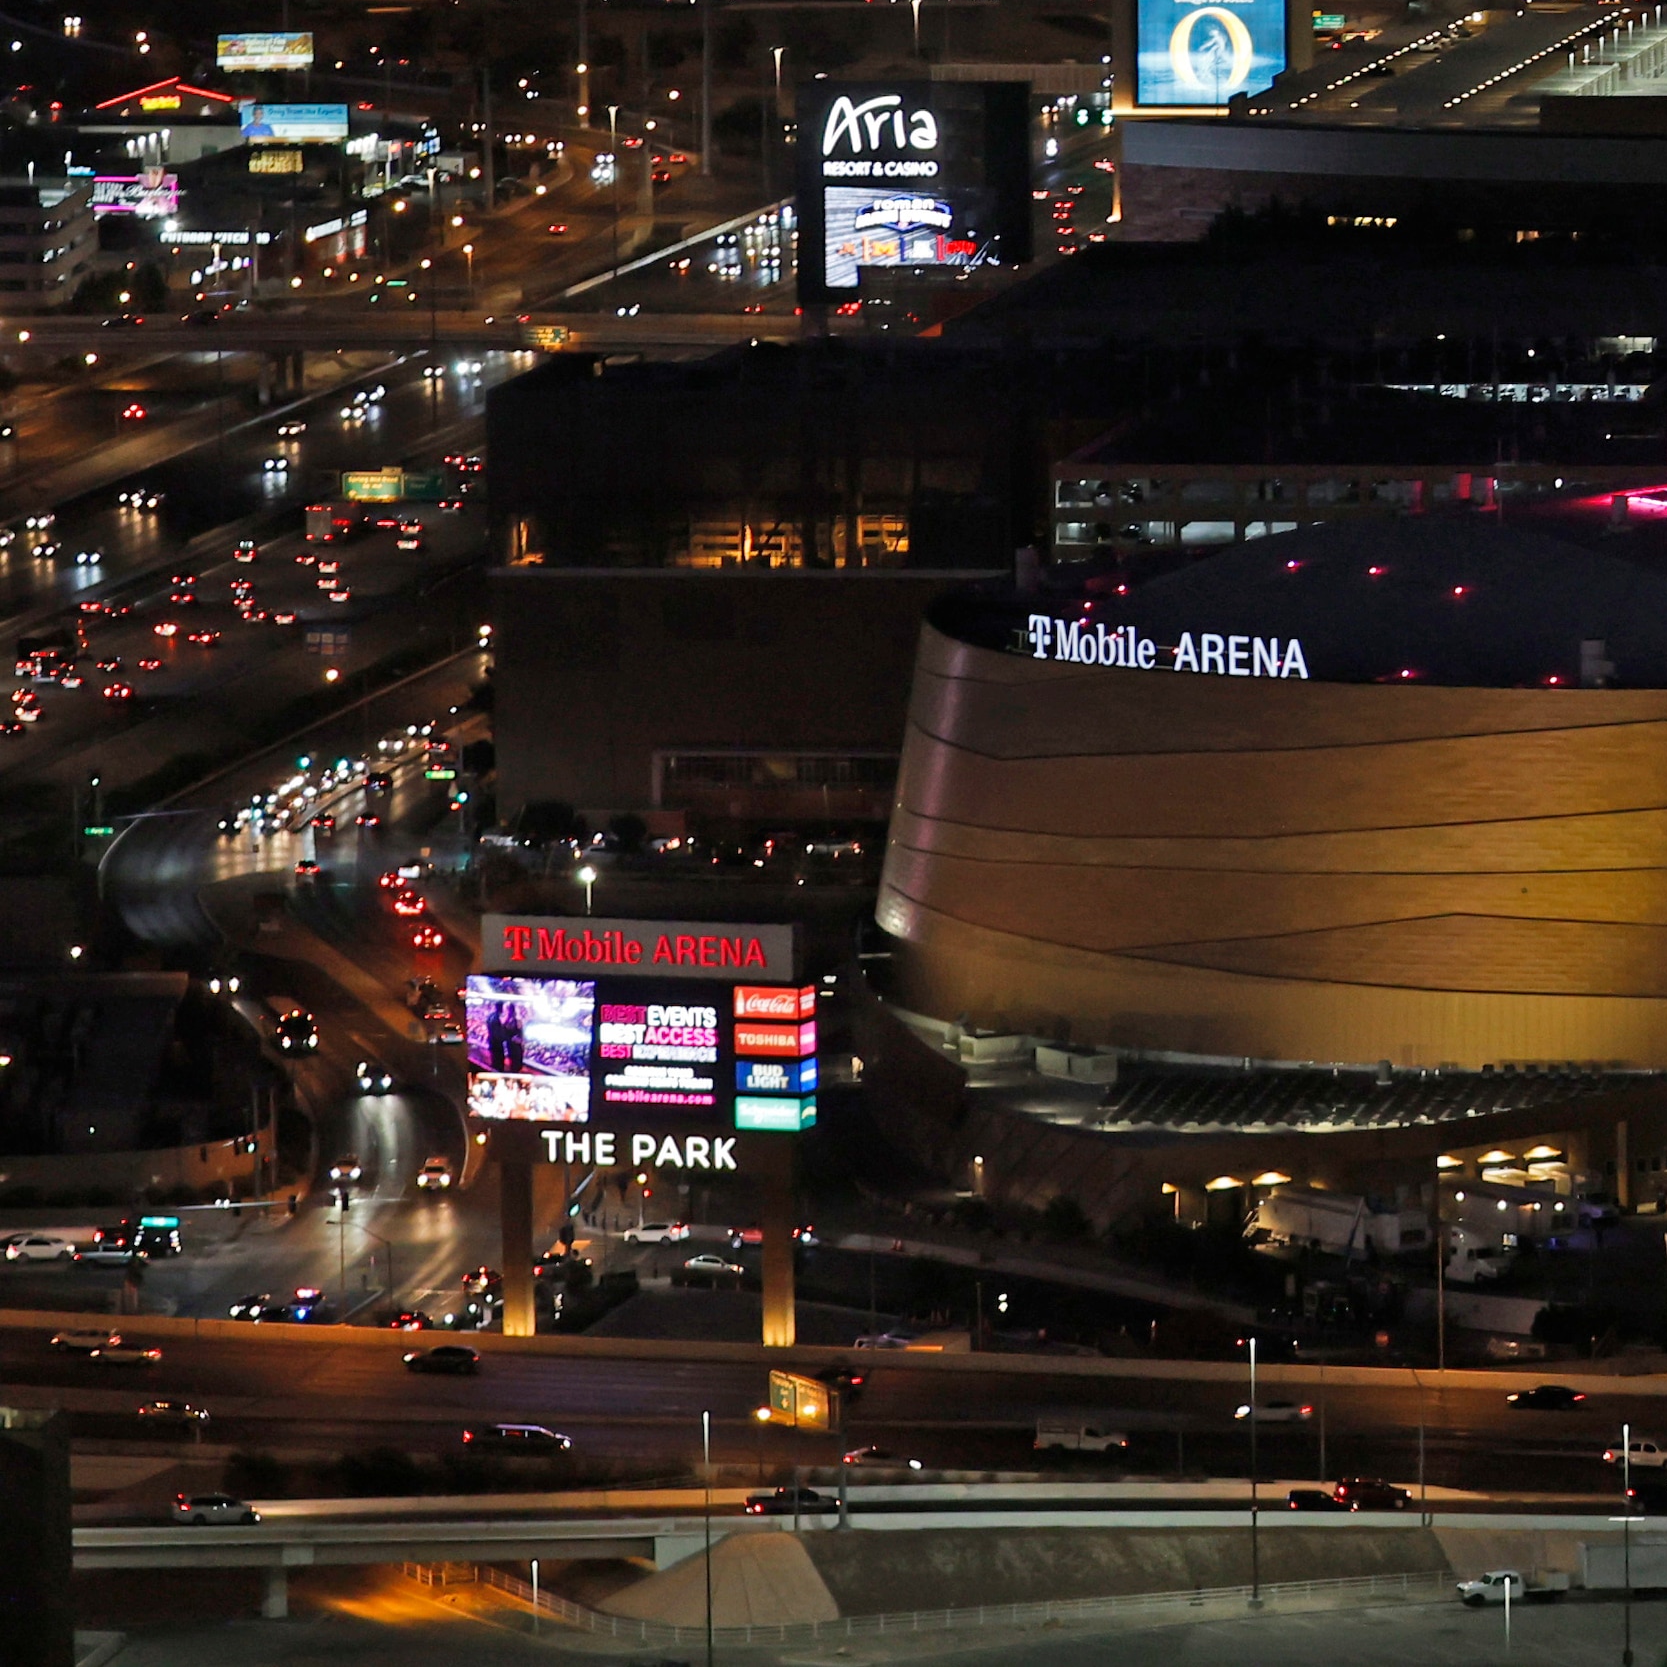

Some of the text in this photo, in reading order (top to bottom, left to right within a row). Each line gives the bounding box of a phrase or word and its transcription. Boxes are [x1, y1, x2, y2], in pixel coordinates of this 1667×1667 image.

[822, 95, 938, 156] Aria
[822, 161, 939, 178] RESORT & CASINO
[1173, 631, 1309, 680] ARENA
[652, 934, 768, 969] ARENA
[600, 1004, 717, 1028] BEST EVENTS
[600, 1022, 717, 1047] BEST ACCESS
[738, 1033, 797, 1047] TOSHIBA
[600, 1044, 632, 1059] BEST
[746, 1075, 790, 1089] LIGHT
[752, 1064, 784, 1077] BUD
[541, 1130, 738, 1170] THE PARK
